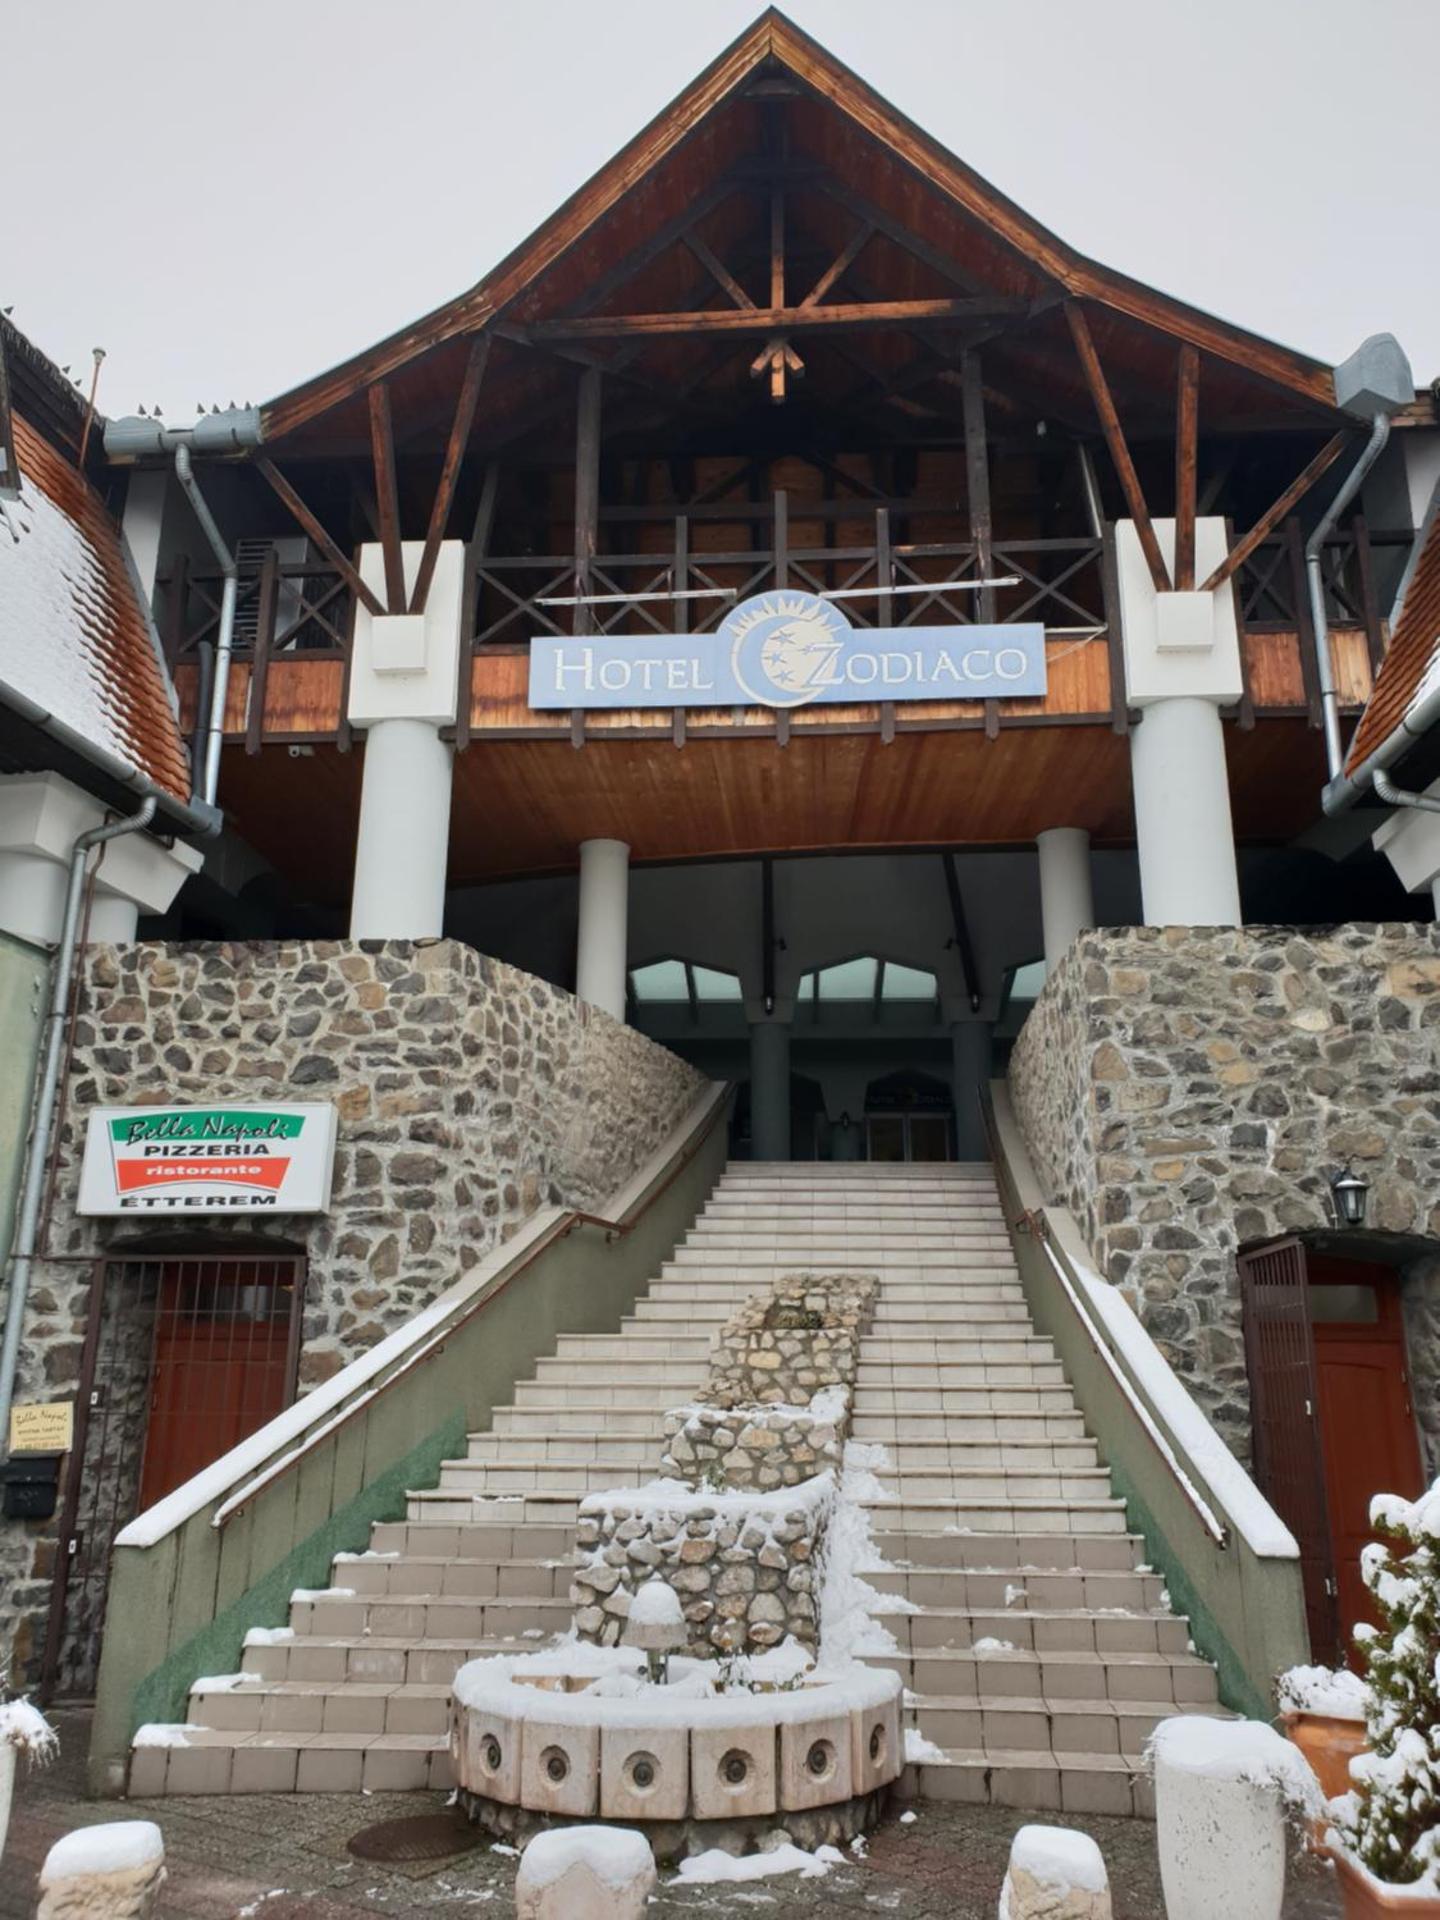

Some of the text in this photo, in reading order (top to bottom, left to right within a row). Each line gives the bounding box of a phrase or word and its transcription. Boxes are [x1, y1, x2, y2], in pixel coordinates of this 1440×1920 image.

[554, 642, 1027, 691] HOTEL ZODIACO
[126, 1115, 290, 1146] Bella Napoli
[144, 1144, 270, 1157] PIZZERIA
[146, 1163, 262, 1176] ristorante
